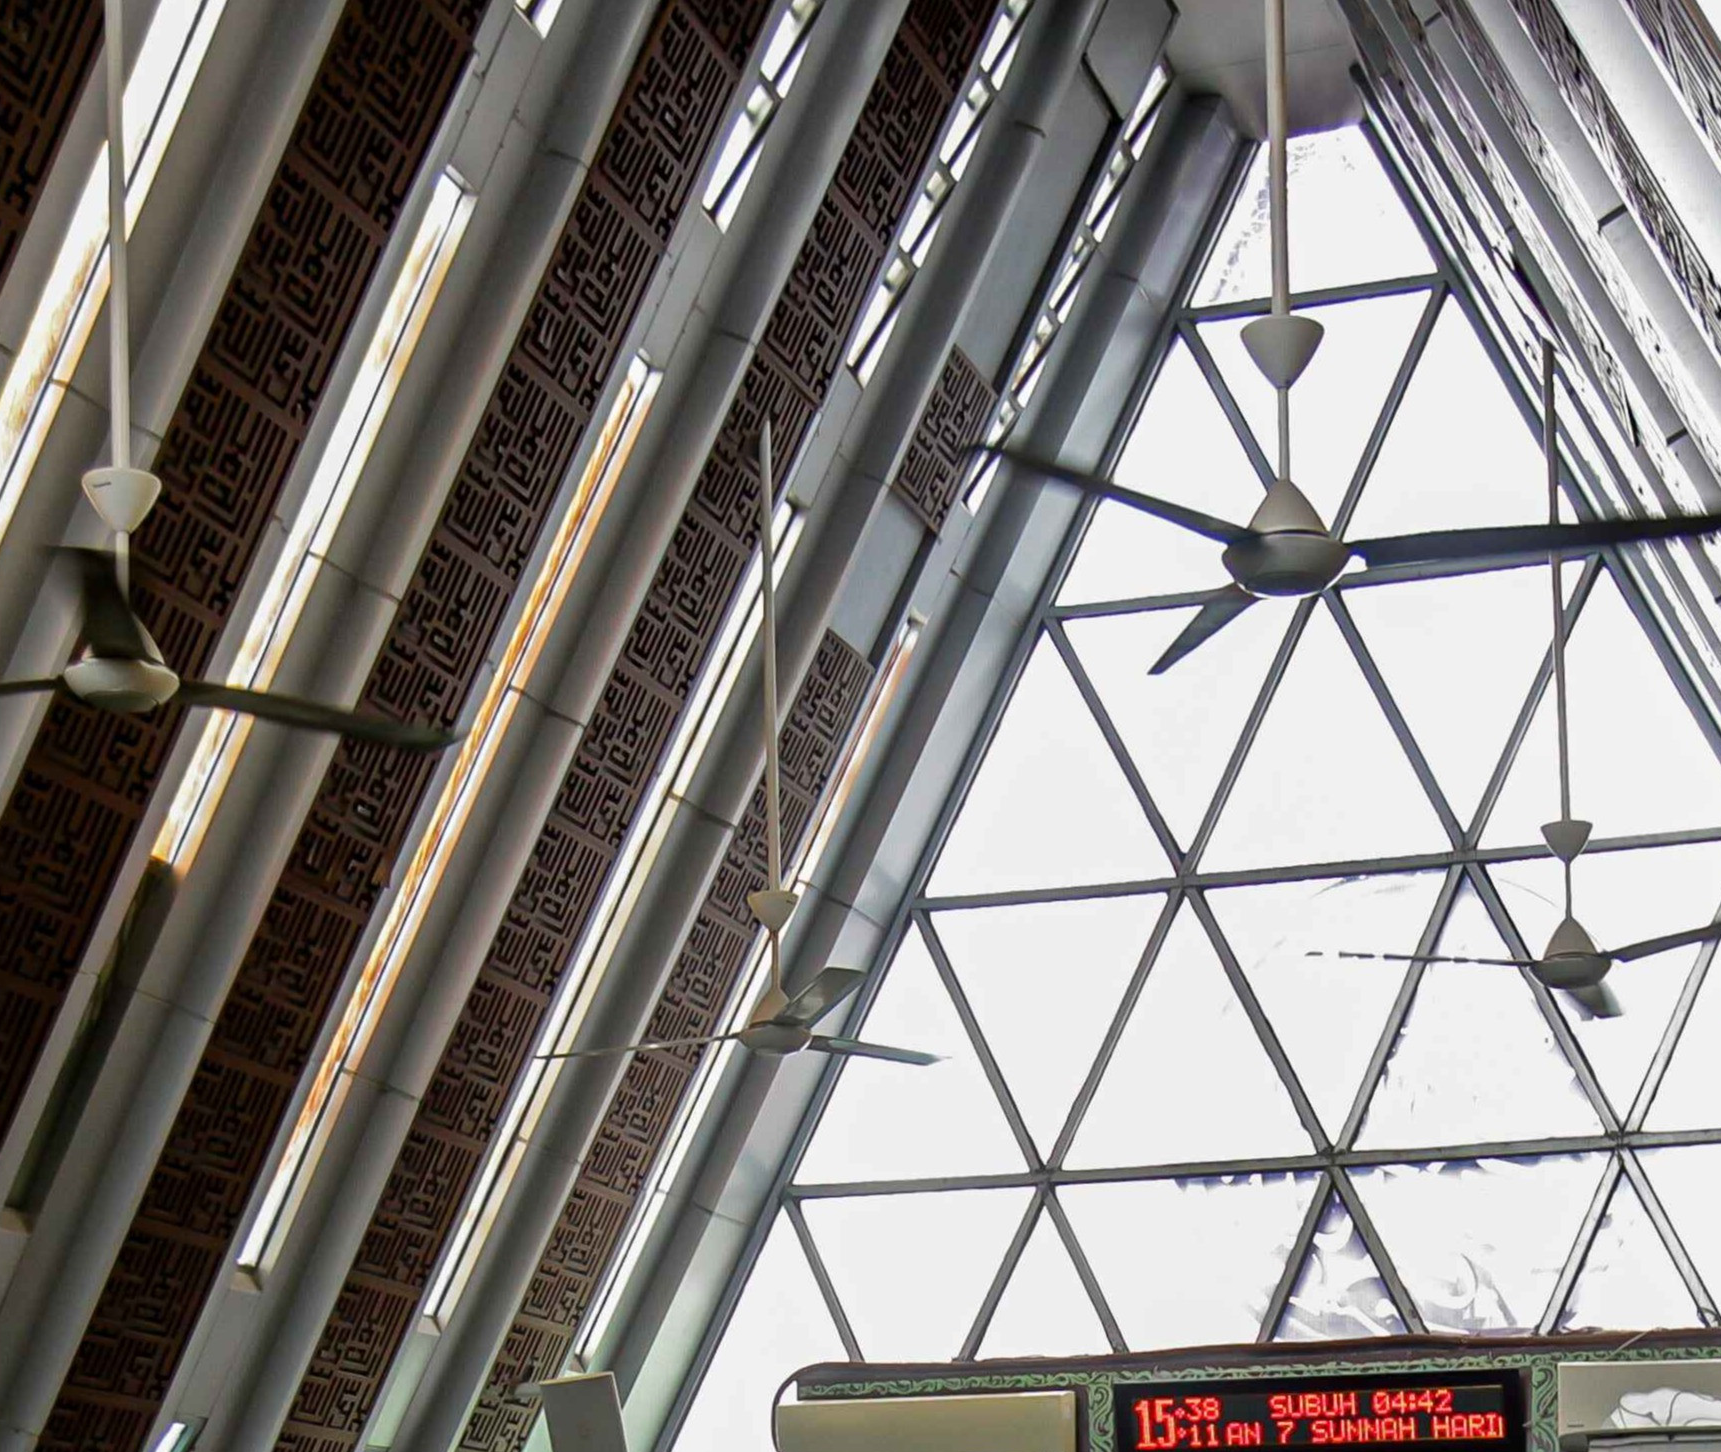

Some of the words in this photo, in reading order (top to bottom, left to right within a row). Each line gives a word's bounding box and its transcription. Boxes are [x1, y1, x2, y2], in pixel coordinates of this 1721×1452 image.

[1269, 1391, 1356, 1419] SUBUH
[1373, 1388, 1453, 1415] 04:42
[1226, 1420, 1262, 1446] AN
[1276, 1420, 1294, 1444] 7
[1311, 1416, 1416, 1444] SUNNAH
[1432, 1412, 1504, 1440] HARI
